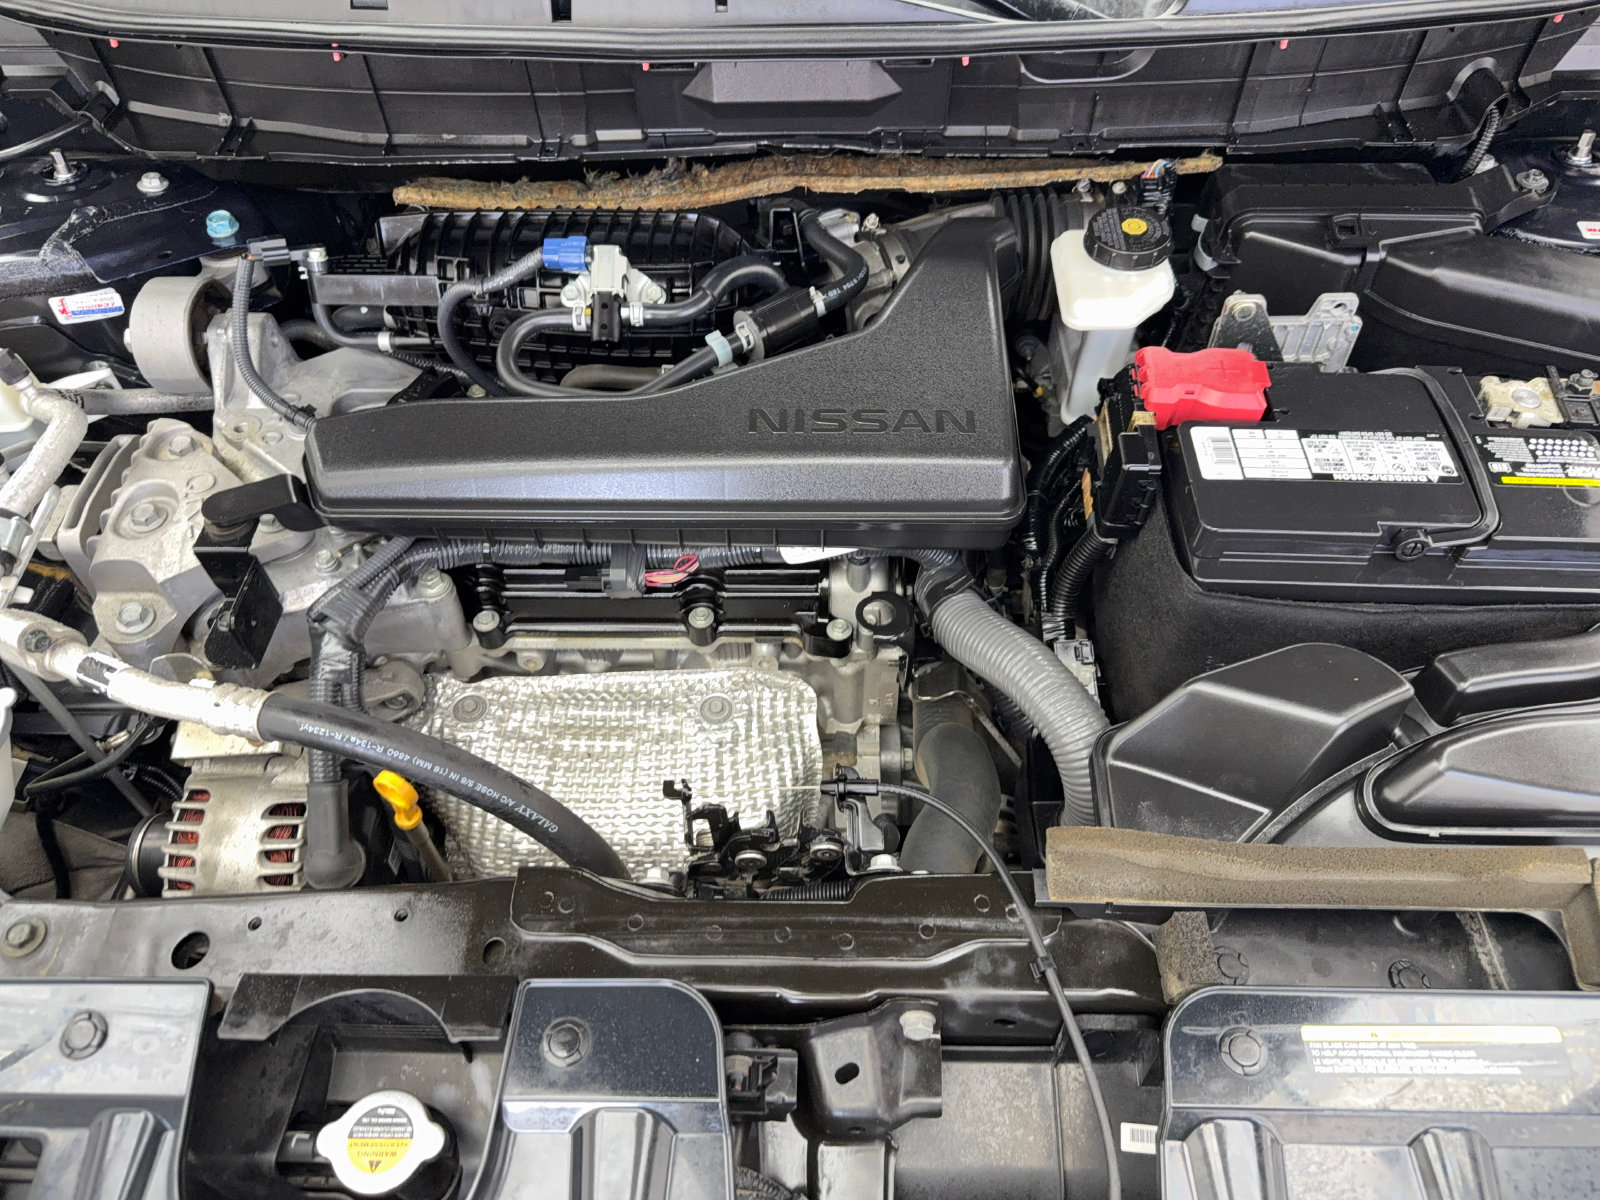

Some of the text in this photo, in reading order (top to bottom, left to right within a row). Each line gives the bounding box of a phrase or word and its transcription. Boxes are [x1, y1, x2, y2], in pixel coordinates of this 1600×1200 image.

[749, 408, 977, 434] NISSAN
[412, 755, 434, 772] MM)
[448, 771, 461, 783] IN
[460, 775, 475, 789] 5/8
[475, 782, 500, 800] HOSE
[500, 788, 516, 806] A/C
[514, 804, 560, 834] GALAXY
